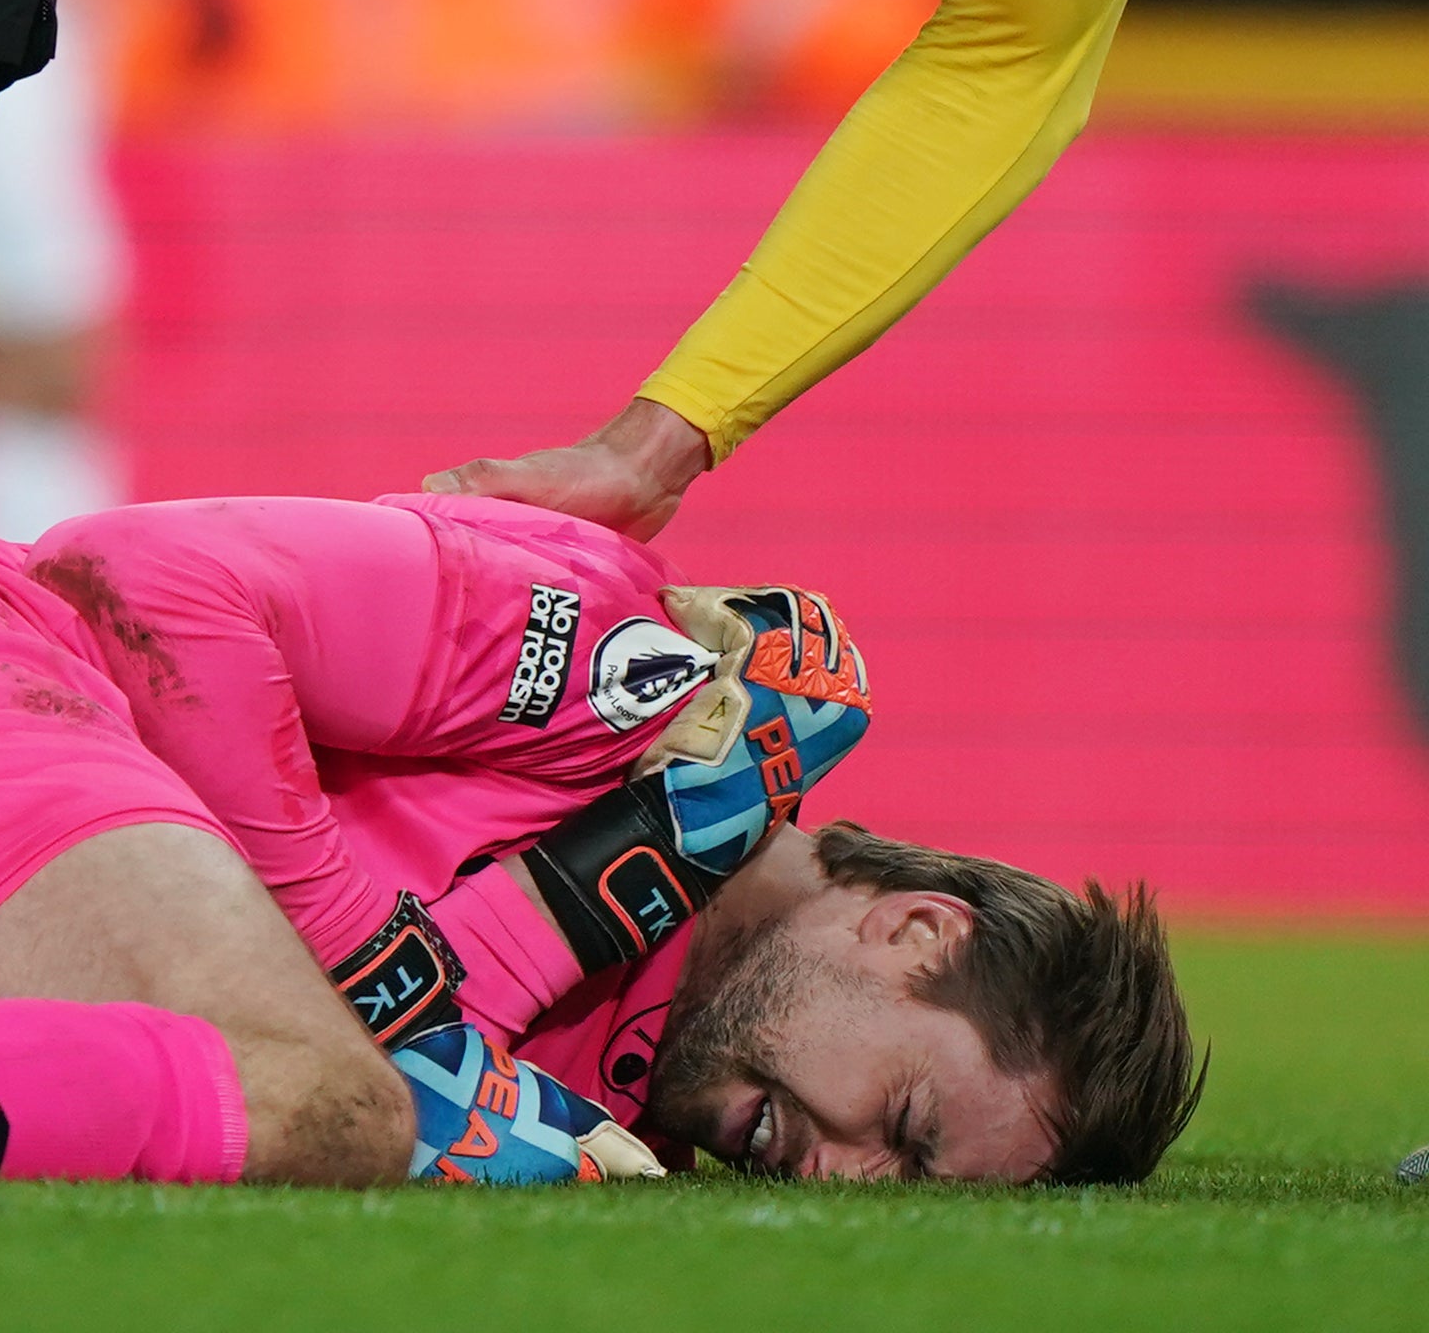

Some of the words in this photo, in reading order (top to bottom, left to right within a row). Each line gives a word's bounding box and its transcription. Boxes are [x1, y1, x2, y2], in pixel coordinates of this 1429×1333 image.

[530, 582, 554, 629] for
[551, 588, 581, 635] No
[498, 630, 544, 722] racism
[526, 636, 568, 716] room
[639, 887, 677, 942] TK
[352, 965, 424, 1025] TK
